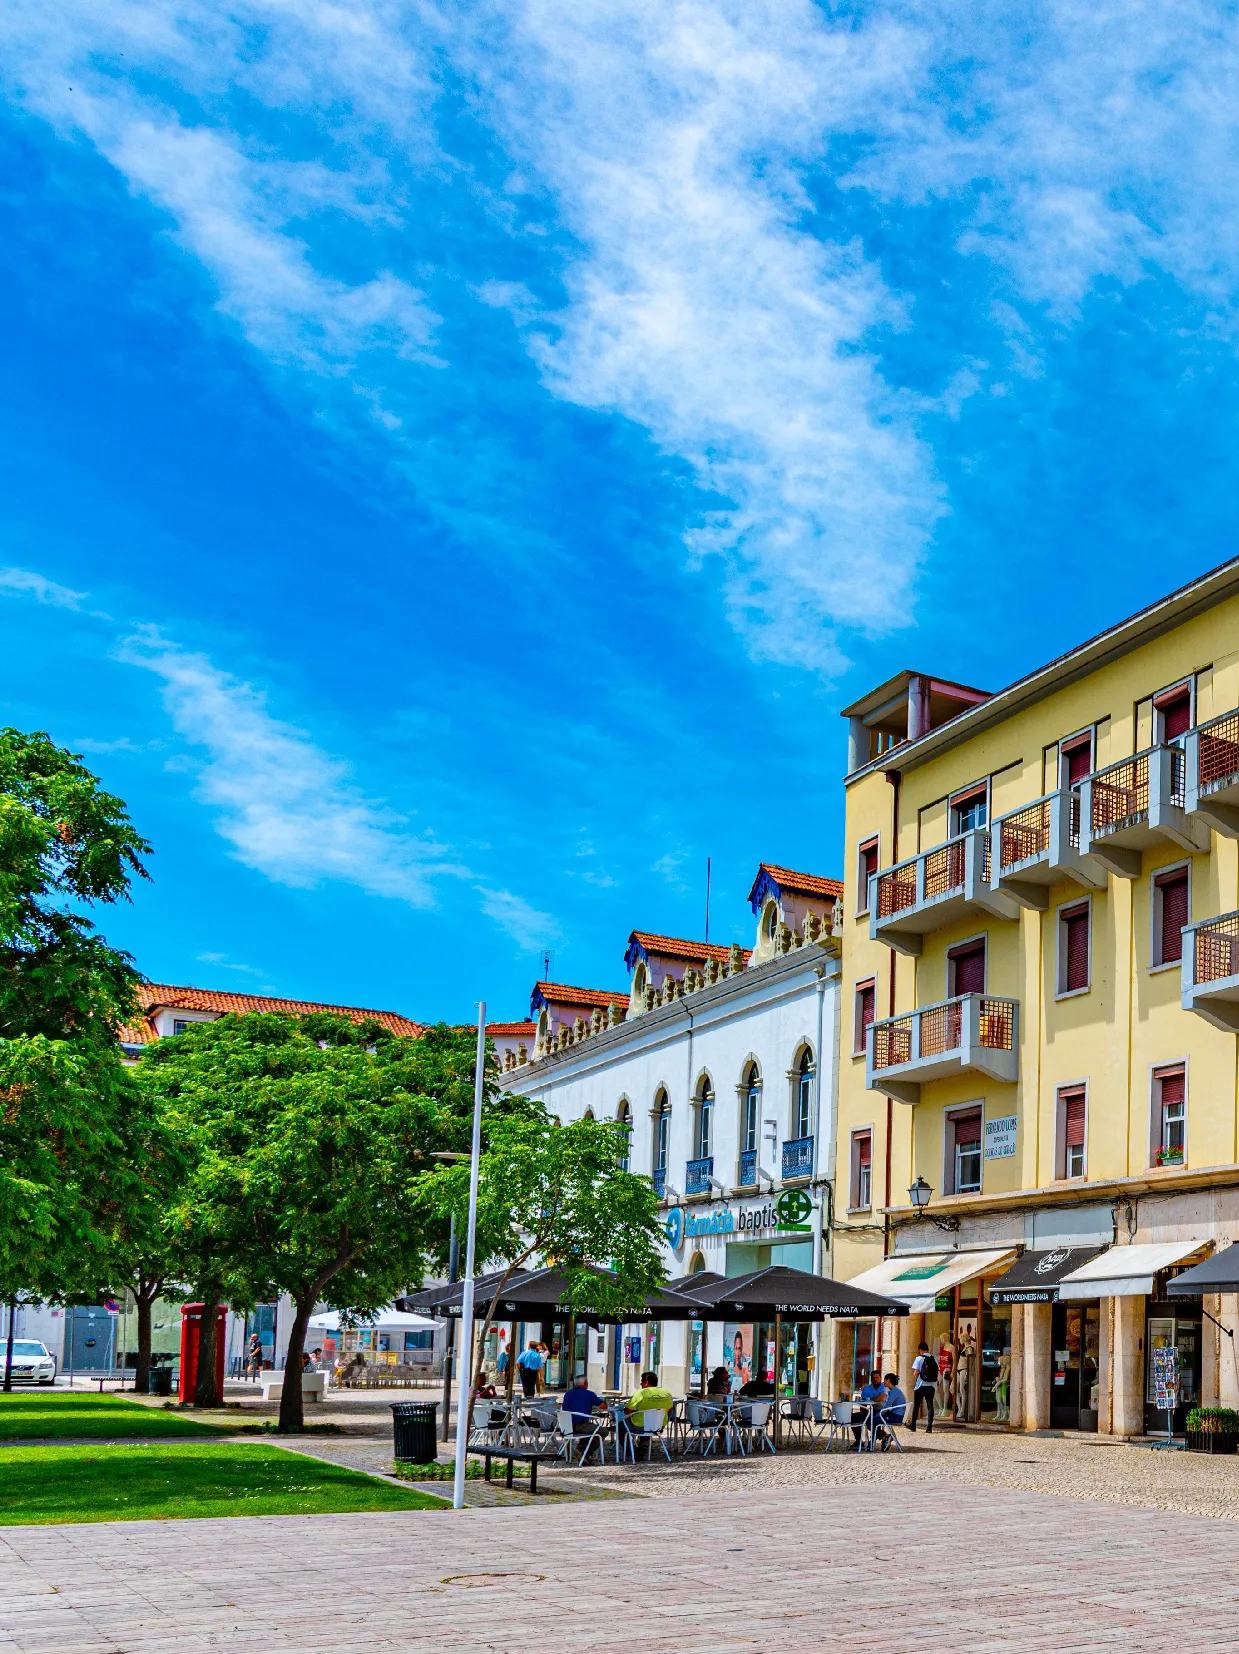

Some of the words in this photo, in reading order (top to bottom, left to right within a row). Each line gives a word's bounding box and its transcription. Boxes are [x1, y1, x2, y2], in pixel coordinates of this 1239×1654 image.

[738, 1203, 789, 1236] baptis
[555, 1304, 569, 1313] THE
[630, 1307, 652, 1315] NTA
[775, 1304, 788, 1312] THE
[789, 1304, 815, 1312] WORLD
[816, 1305, 838, 1313] NEEDS
[839, 1306, 859, 1314] NATA
